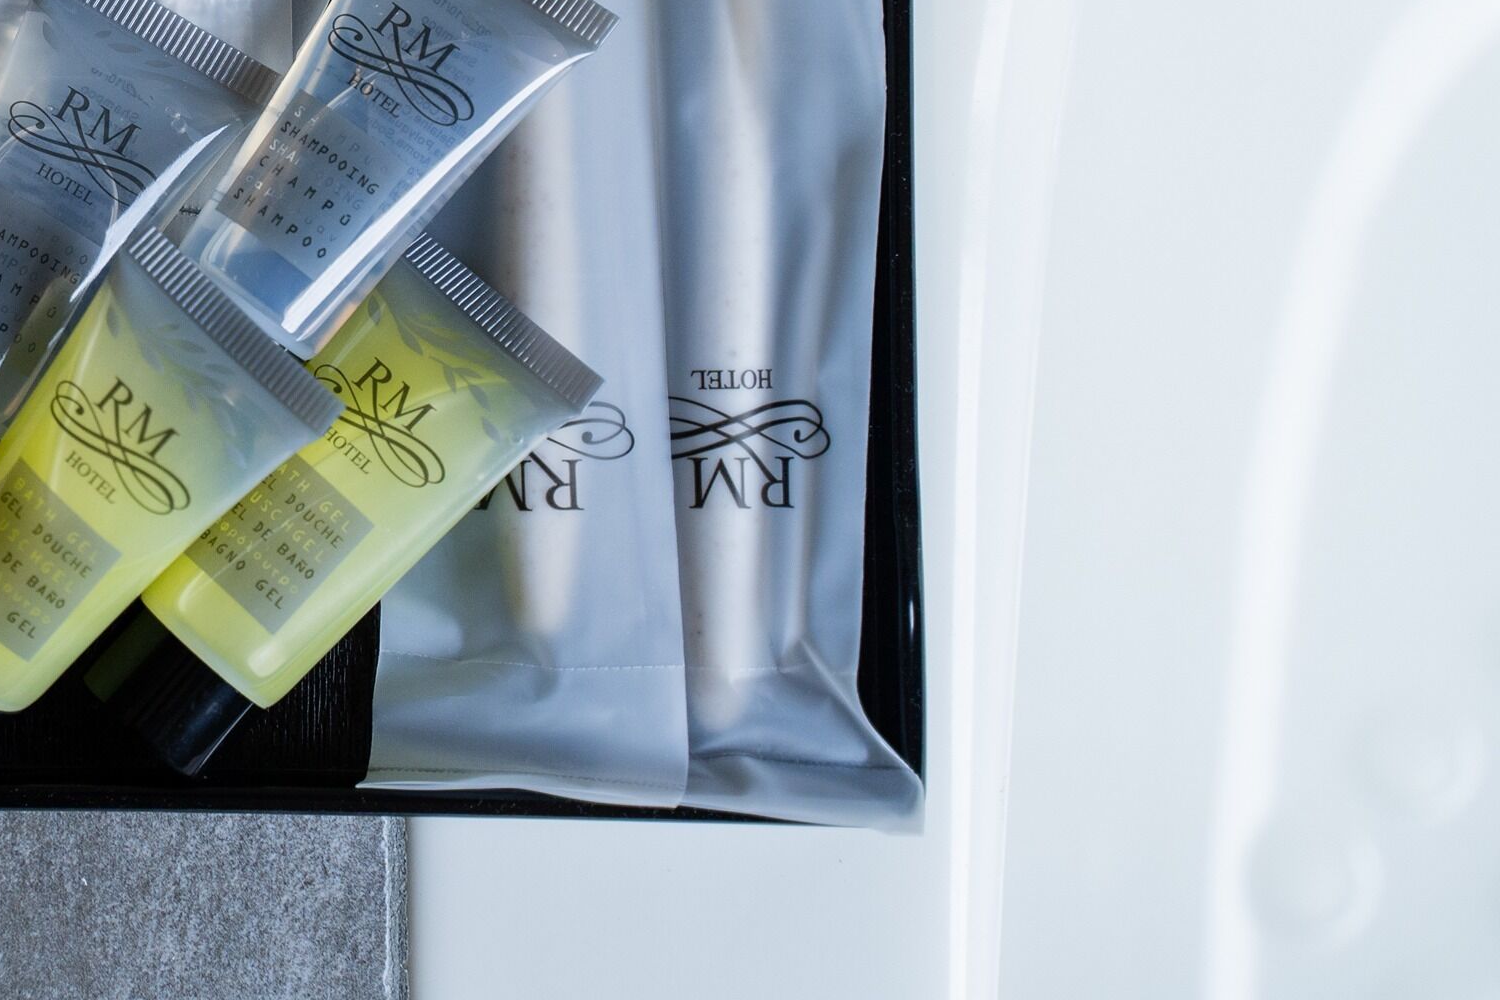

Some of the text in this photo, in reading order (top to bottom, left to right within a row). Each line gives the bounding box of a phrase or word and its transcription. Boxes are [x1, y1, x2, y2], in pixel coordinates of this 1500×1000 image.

[372, 2, 460, 75] RM
[52, 85, 142, 157] RM
[348, 71, 401, 119] HOTEL
[36, 162, 93, 205] HOTEL
[280, 120, 380, 195] SHAMPOOING
[233, 187, 327, 259] SHAMPOO
[351, 357, 436, 434] RM
[690, 369, 773, 390] HOTEL
[94, 376, 179, 460] RM
[324, 426, 372, 474] HOTEL
[65, 450, 116, 504] HOTEL
[261, 473, 344, 549] EL DOUCHE
[277, 463, 350, 533] ATH GEL
[688, 456, 795, 509] RM
[1, 491, 93, 579] GEL DOUCHE
[231, 502, 315, 580] EL DE BAÑO
[250, 491, 324, 562] USCHGEL
[2, 551, 23, 574] DE
[26, 575, 65, 609] BAÑO
[200, 529, 284, 610] BAGNO GEL
[6, 611, 37, 639] GEL
